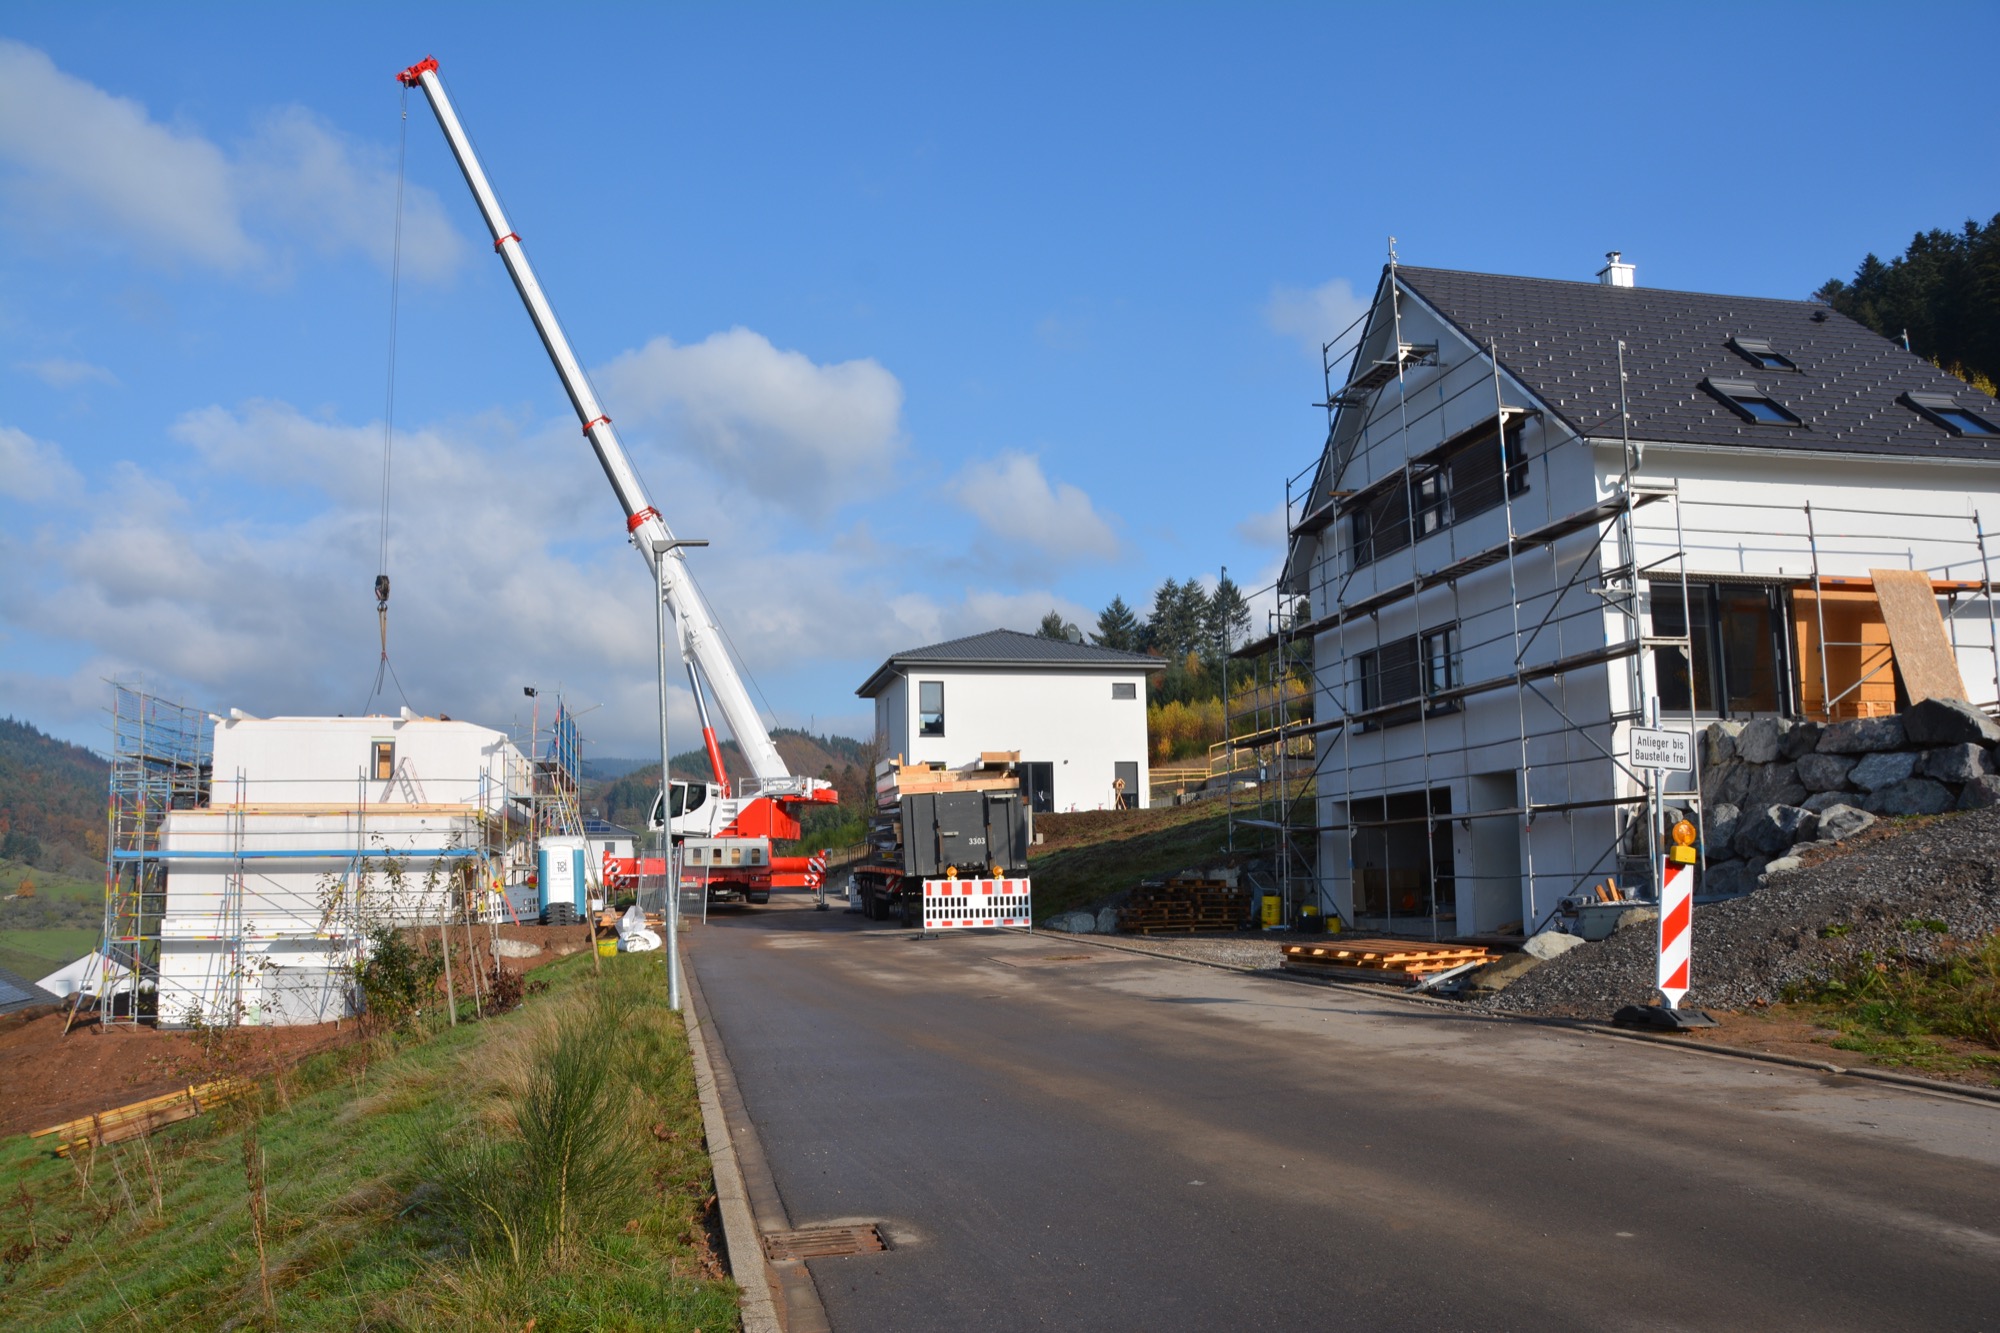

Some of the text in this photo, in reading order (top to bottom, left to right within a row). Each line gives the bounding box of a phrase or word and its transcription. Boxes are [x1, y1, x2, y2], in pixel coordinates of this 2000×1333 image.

[1637, 735, 1684, 750] Anlieger bis
[1635, 749, 1686, 764] Baustelle frei
